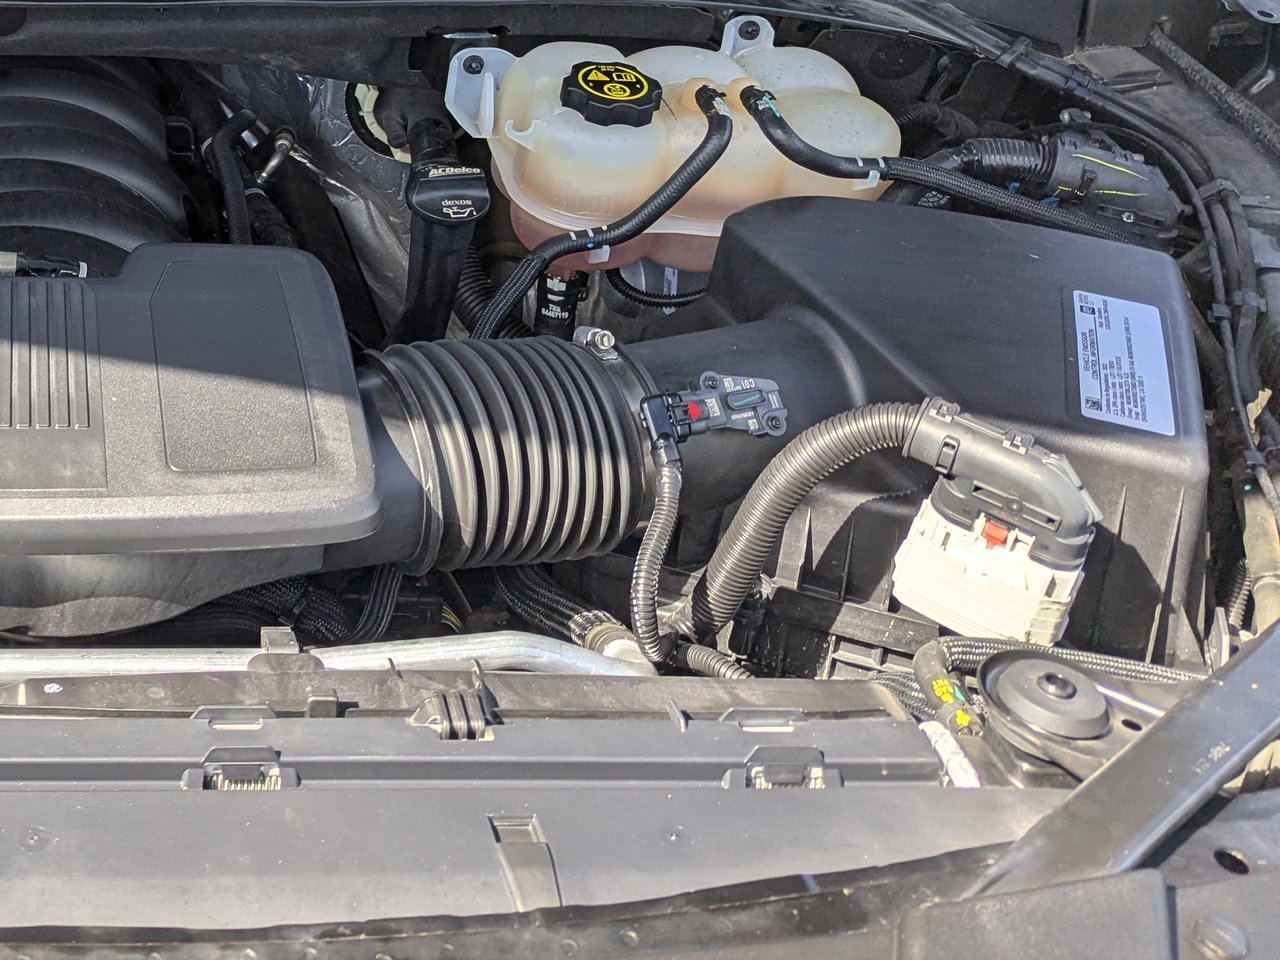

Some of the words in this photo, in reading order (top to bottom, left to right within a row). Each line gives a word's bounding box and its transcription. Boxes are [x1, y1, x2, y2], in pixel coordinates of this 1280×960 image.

[429, 167, 480, 178] ACDelco
[1081, 331, 1089, 353] EMISSION
[1088, 328, 1097, 358] INFORMATION
[1082, 353, 1091, 373] VEHICLE
[1090, 358, 1099, 381] CONTROL
